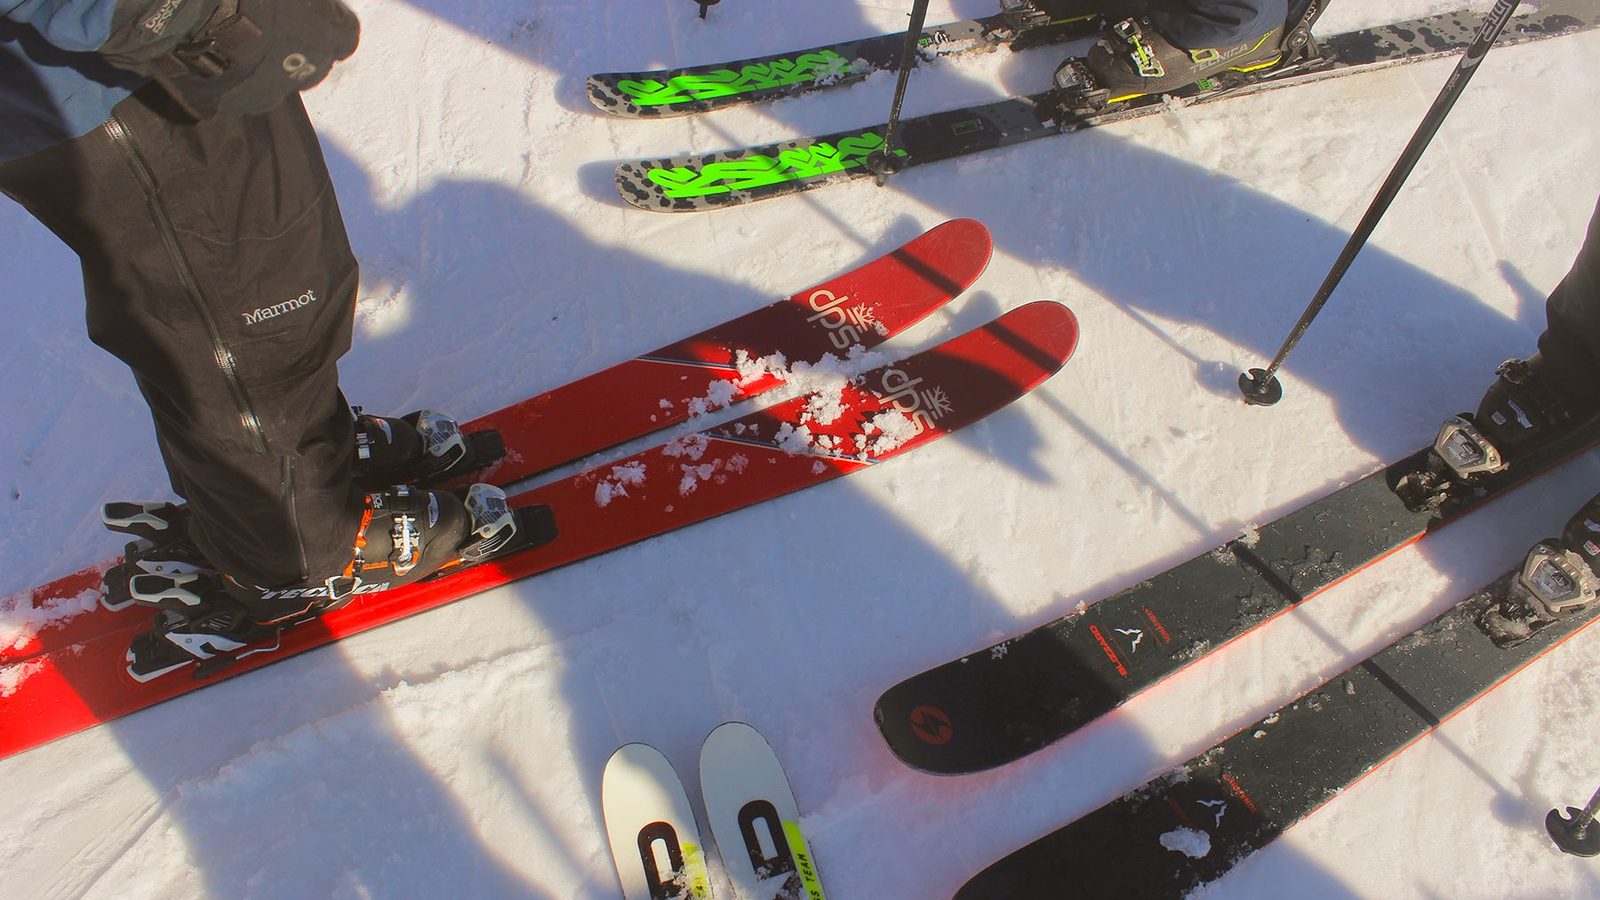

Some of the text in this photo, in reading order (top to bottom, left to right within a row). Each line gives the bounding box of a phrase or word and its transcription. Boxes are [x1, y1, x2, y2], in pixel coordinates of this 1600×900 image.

[242, 289, 317, 326] Marmot
[807, 289, 861, 350] dps
[878, 368, 936, 436] dps
[261, 582, 390, 600] TECCA
[797, 852, 815, 882] TEAM
